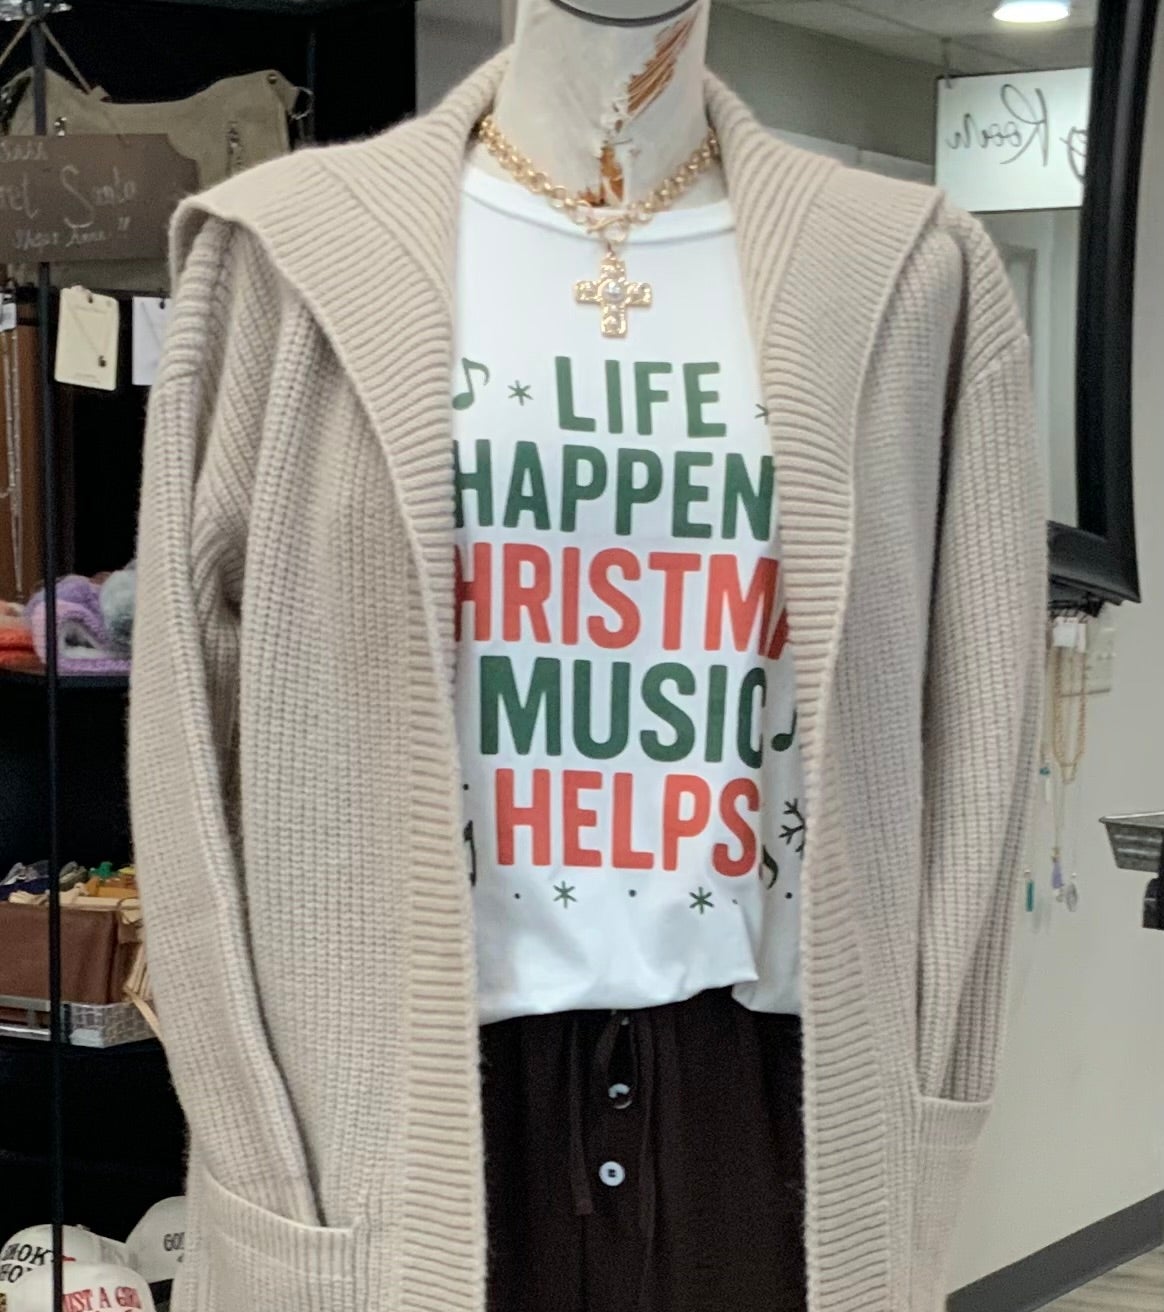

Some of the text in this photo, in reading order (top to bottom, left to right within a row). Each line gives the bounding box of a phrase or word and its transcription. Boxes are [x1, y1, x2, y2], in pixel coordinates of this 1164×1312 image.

[555, 356, 727, 438] LIFE
[454, 438, 776, 541] HAPPEN
[454, 542, 788, 660] HRISTM
[480, 655, 767, 769] MUSIC
[495, 768, 761, 878] HELPS
